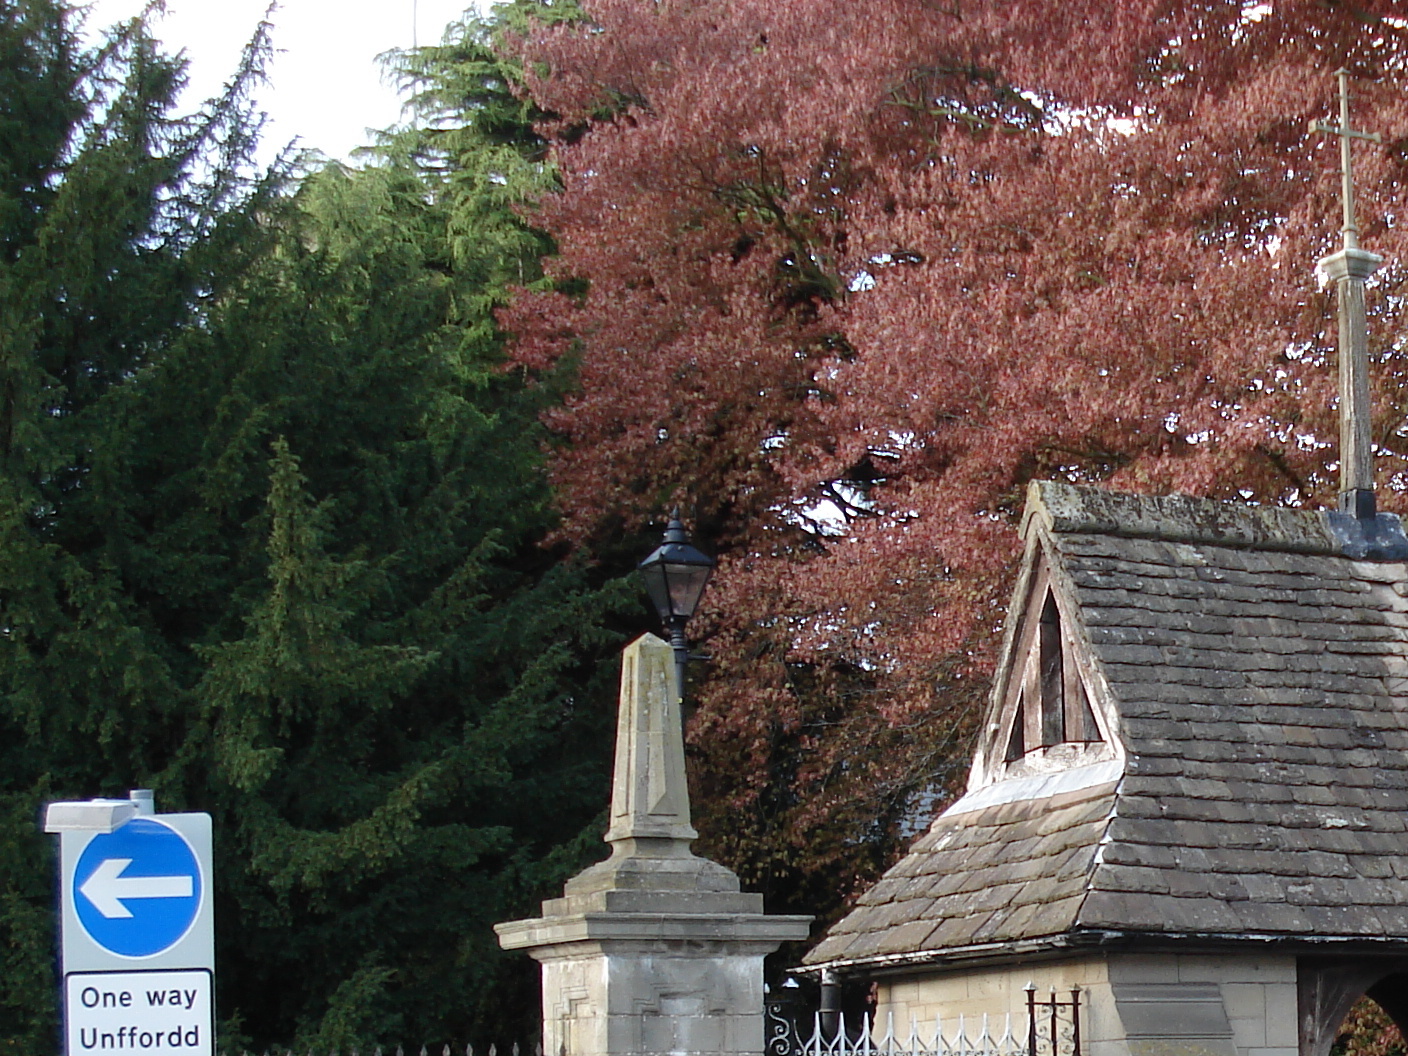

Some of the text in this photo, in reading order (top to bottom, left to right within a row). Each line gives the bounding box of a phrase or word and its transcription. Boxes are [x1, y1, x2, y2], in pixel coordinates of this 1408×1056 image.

[81, 986, 198, 1010] One way
[80, 1025, 199, 1049] Unffordd
